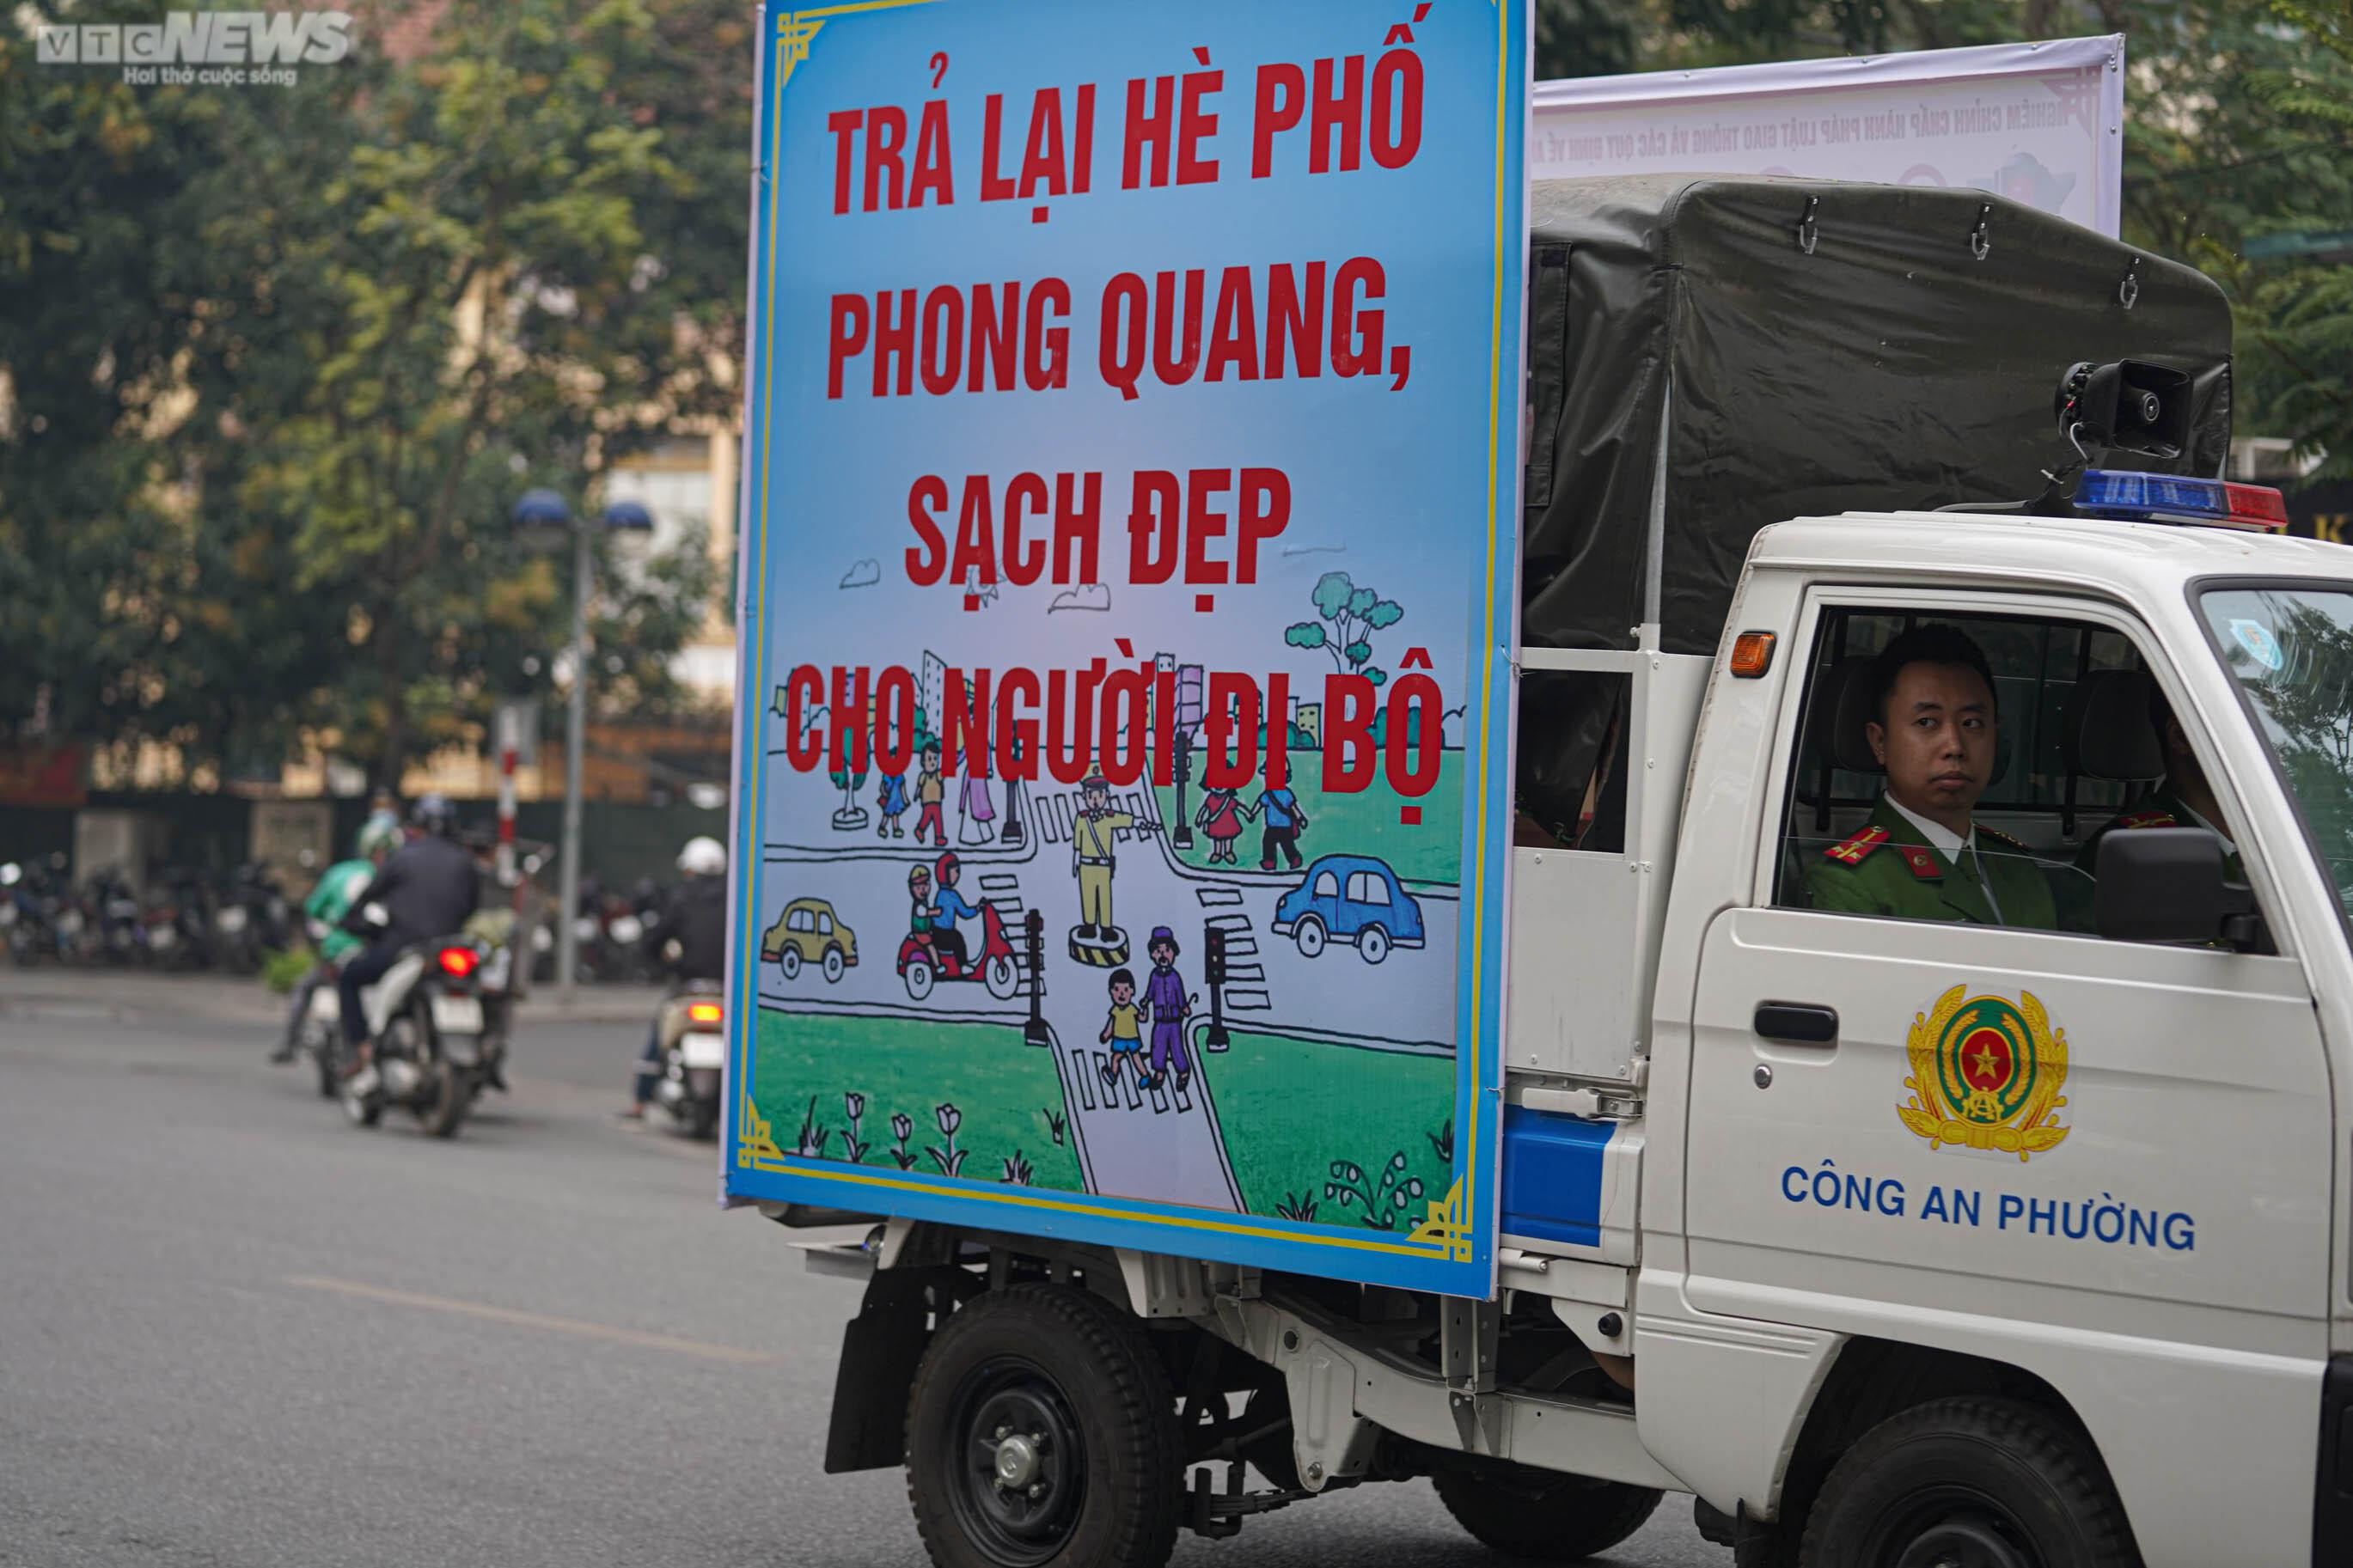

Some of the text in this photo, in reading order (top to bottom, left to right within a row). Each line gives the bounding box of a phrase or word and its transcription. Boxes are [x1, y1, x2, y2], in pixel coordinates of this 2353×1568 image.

[828, 3, 1433, 224] TRẢ LẠI HÈ PHỐ
[827, 257, 1411, 401] PHONG QUANG,
[905, 467, 1292, 613] SẠCH ĐẸP
[785, 638, 1444, 827] CHO NGƯỜI ĐI BỘ
[1782, 1158, 2195, 1250] CÔNG AN PHƯỜNG
